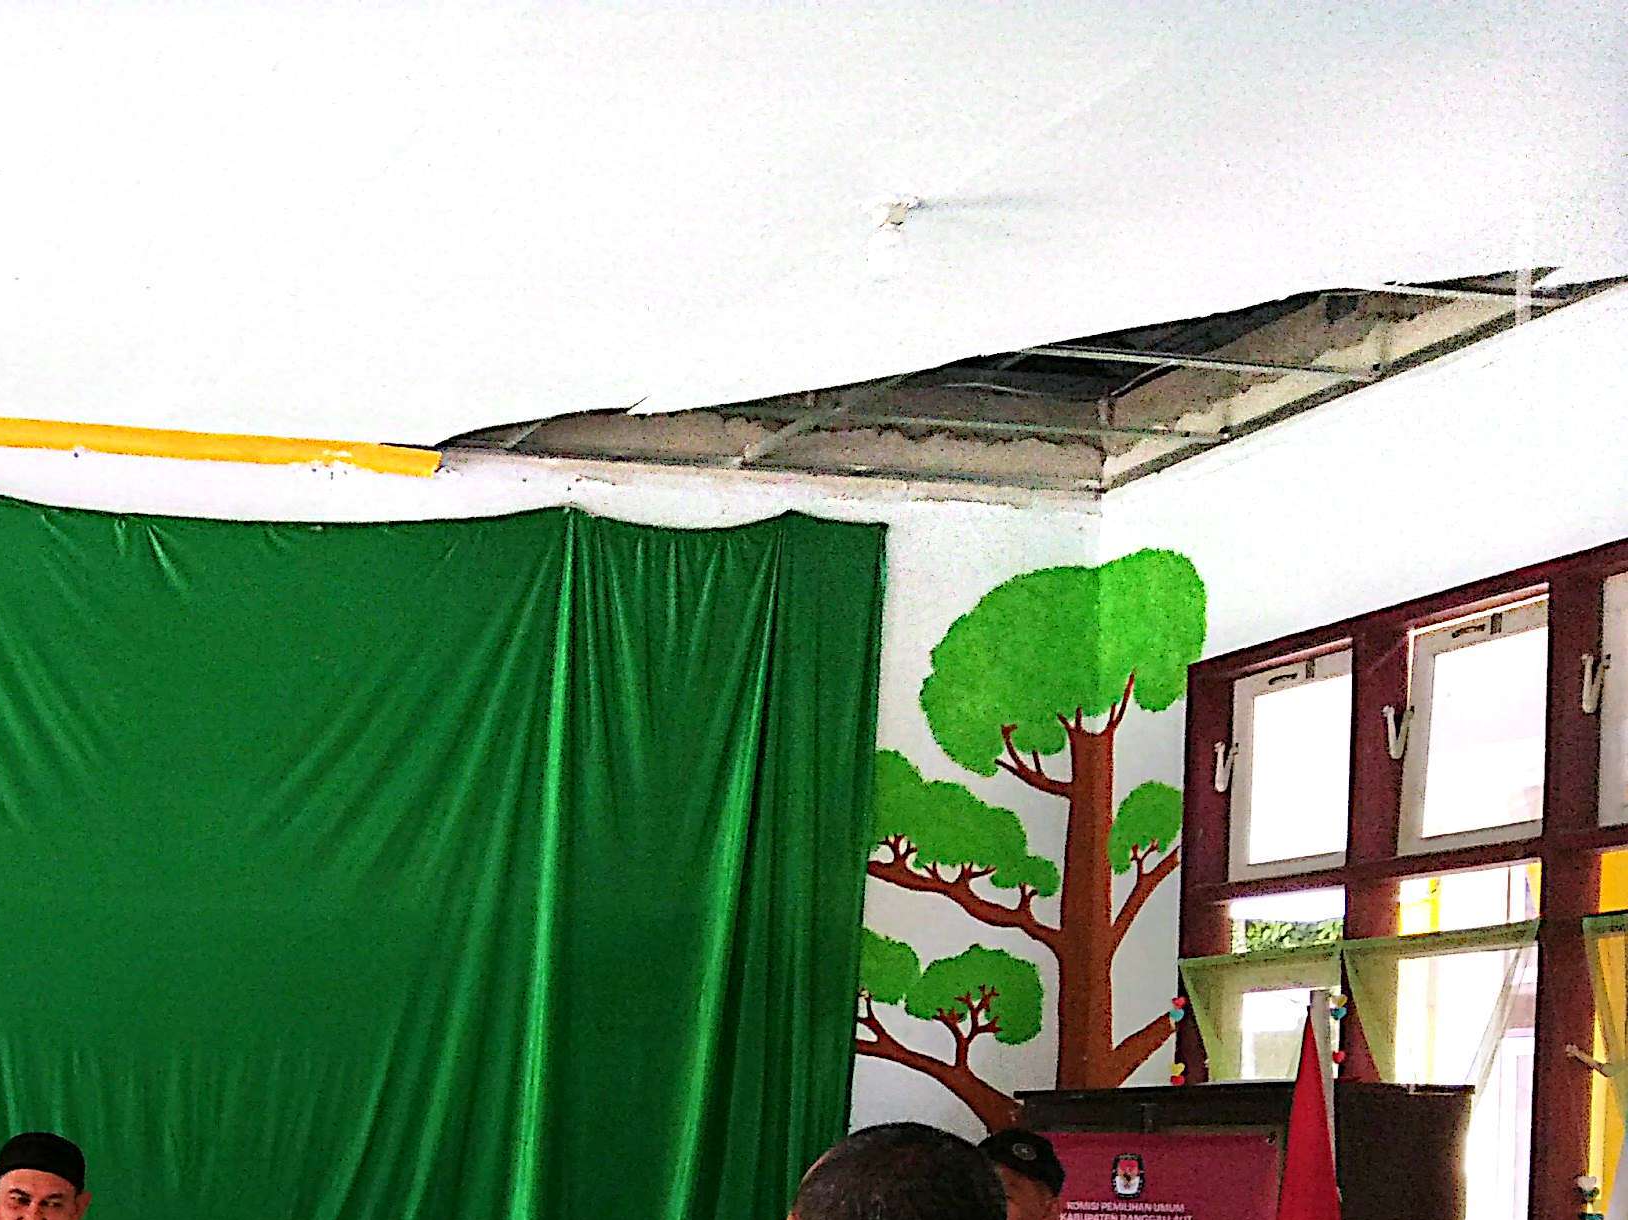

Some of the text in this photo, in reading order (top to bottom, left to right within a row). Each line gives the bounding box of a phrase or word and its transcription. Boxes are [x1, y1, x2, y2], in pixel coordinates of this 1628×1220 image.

[1067, 1202, 1185, 1213] KOMISI PEMILIHAN UMUM
